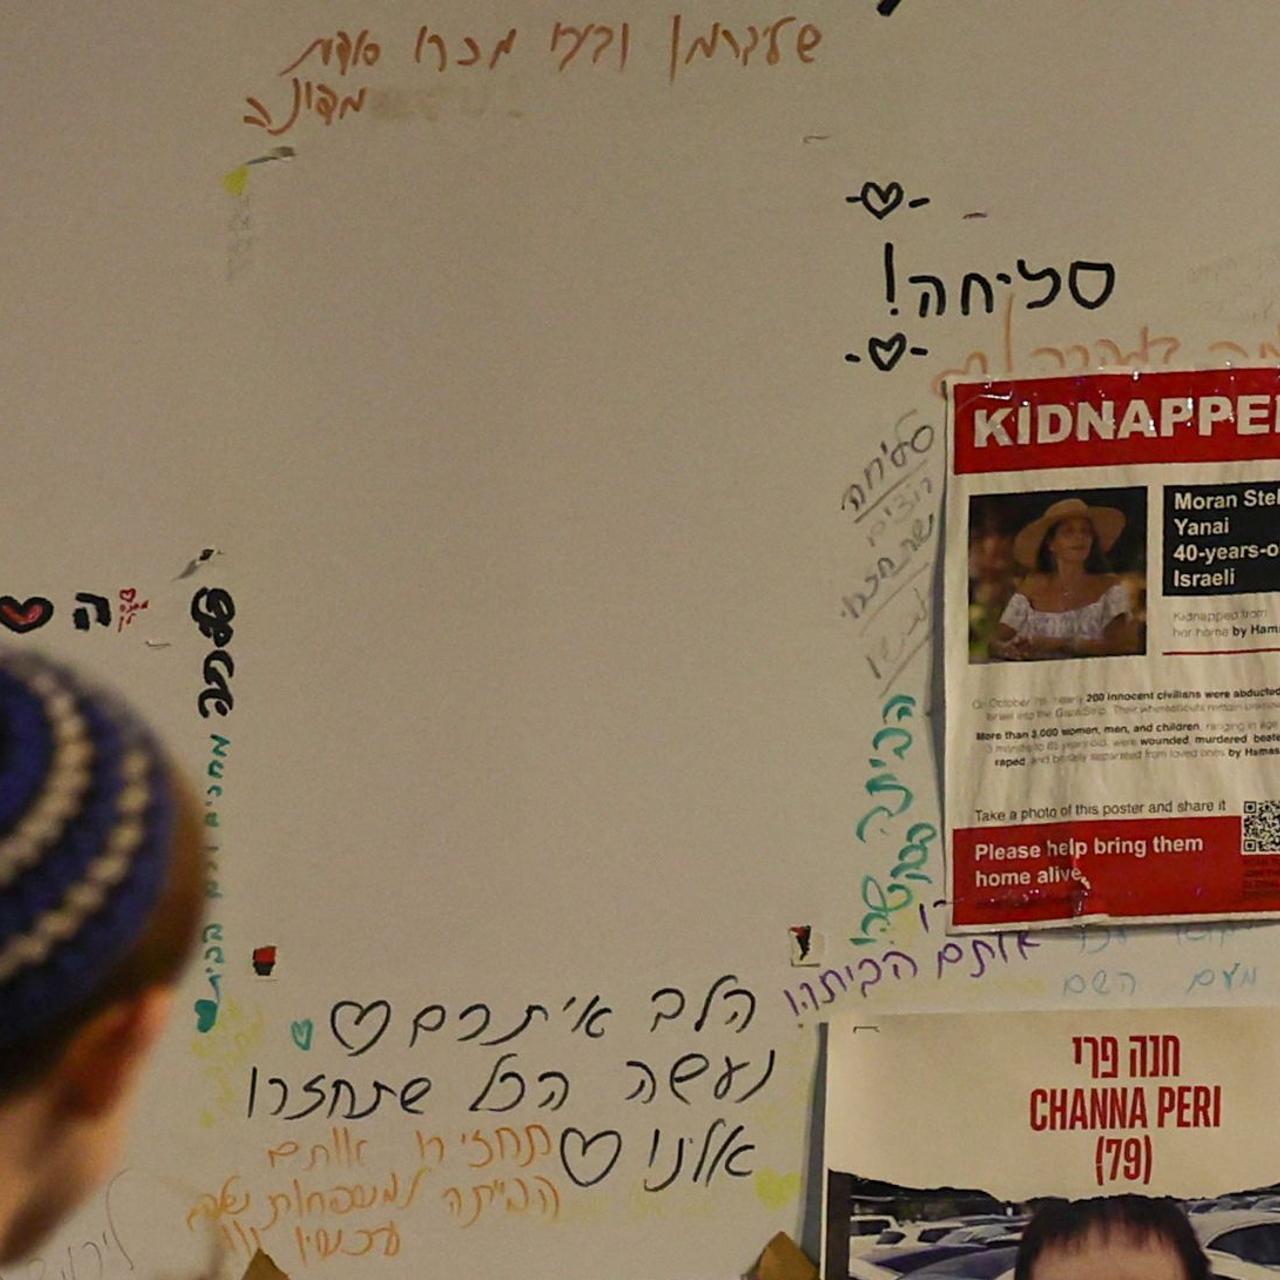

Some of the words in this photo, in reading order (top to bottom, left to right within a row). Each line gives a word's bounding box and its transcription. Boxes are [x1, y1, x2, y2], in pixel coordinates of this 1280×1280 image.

[1174, 492, 1238, 510] Moran
[1174, 517, 1229, 535] Yanai
[1174, 568, 1235, 587] Israeli
[1232, 626, 1247, 638] by
[1107, 691, 1154, 702] innocent
[1157, 690, 1201, 700] civilians
[975, 809, 1006, 823] Take
[1009, 810, 1018, 821] a
[1021, 807, 1057, 822] photo
[1060, 804, 1073, 816] of
[1075, 803, 1099, 815] this
[1103, 802, 1144, 817] poster
[1148, 800, 1173, 813] and
[1177, 800, 1215, 812] share
[1217, 800, 1227, 811] it
[975, 843, 1041, 861] Please
[1046, 838, 1088, 859] help
[1094, 836, 1147, 858] bring
[1153, 835, 1203, 853] them
[975, 869, 1031, 888] home
[1074, 1036, 1120, 1079] פרי
[1130, 1034, 1181, 1078] חנה
[1029, 1086, 1148, 1131] CHANNA
[1157, 1084, 1222, 1129] PERI
[1095, 1137, 1152, 1183] (79)
